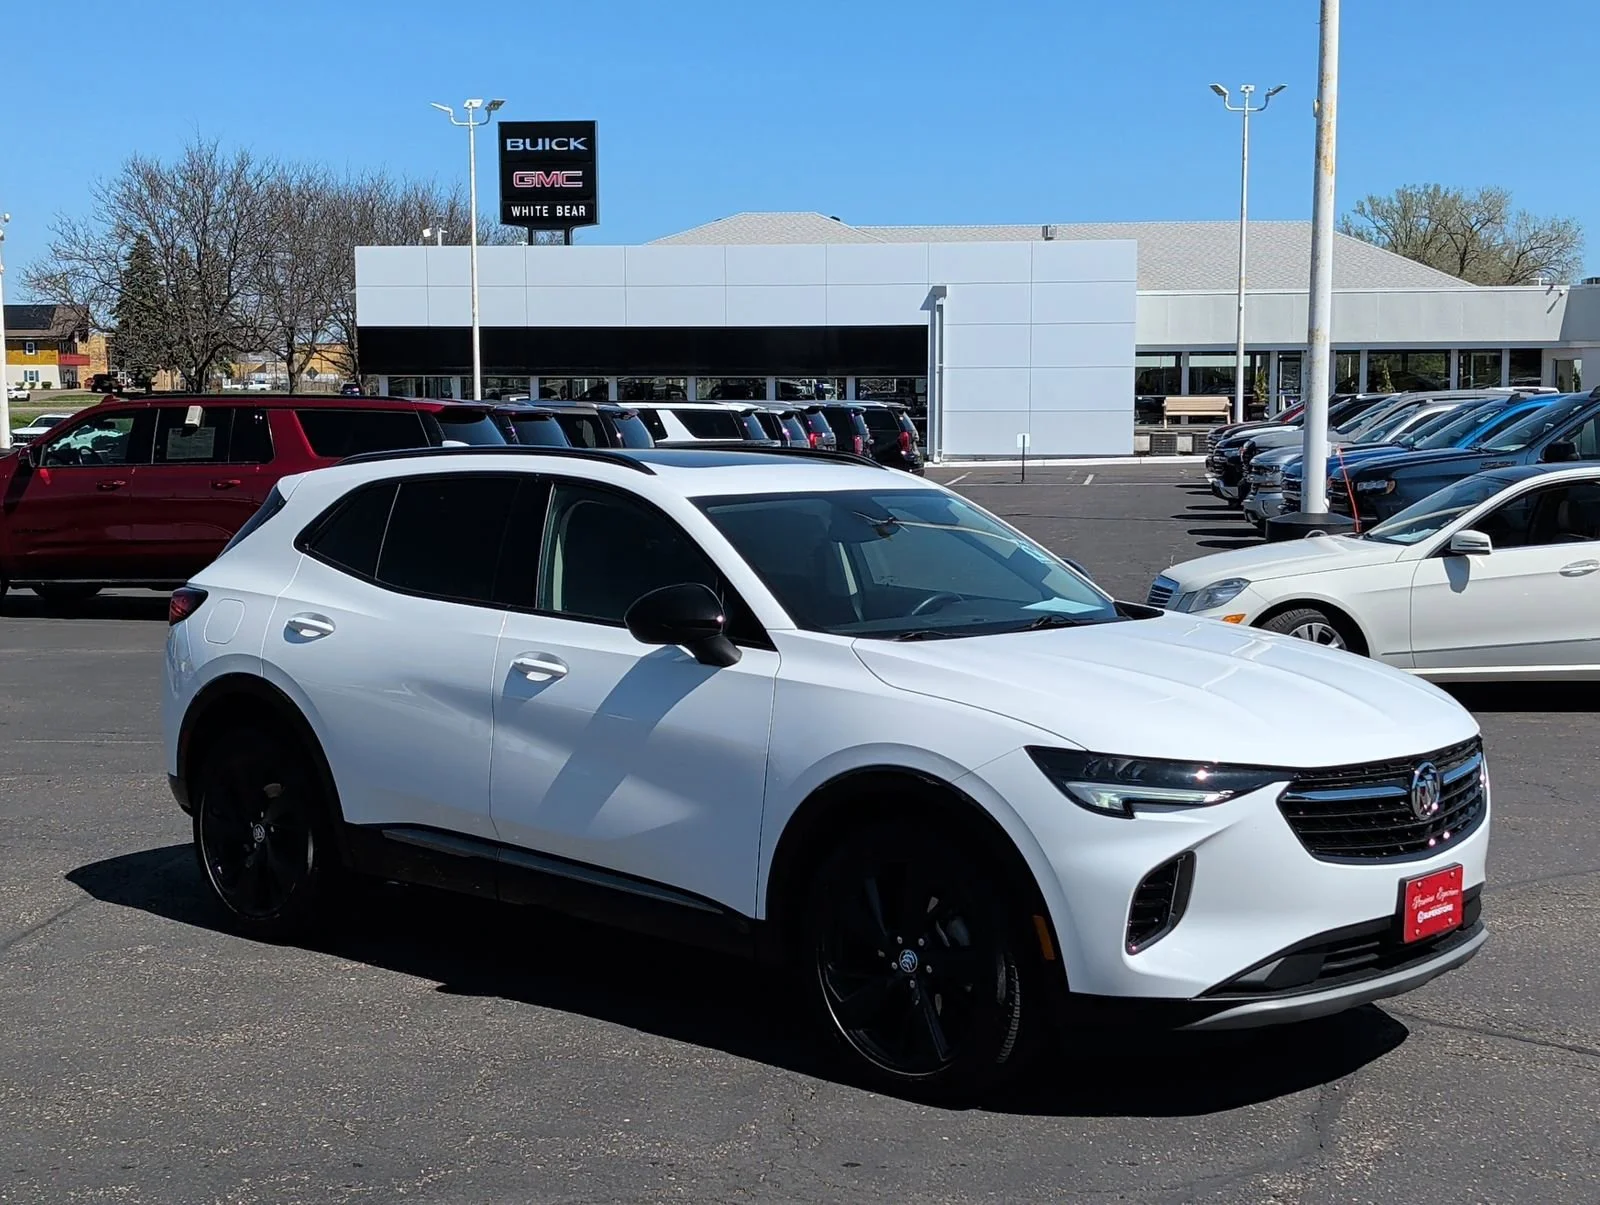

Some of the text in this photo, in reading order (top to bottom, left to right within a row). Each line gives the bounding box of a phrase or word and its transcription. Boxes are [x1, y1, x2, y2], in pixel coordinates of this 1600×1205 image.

[506, 137, 588, 151] BUICK
[513, 170, 583, 187] GMC
[511, 205, 586, 217] WHITE BEAR
